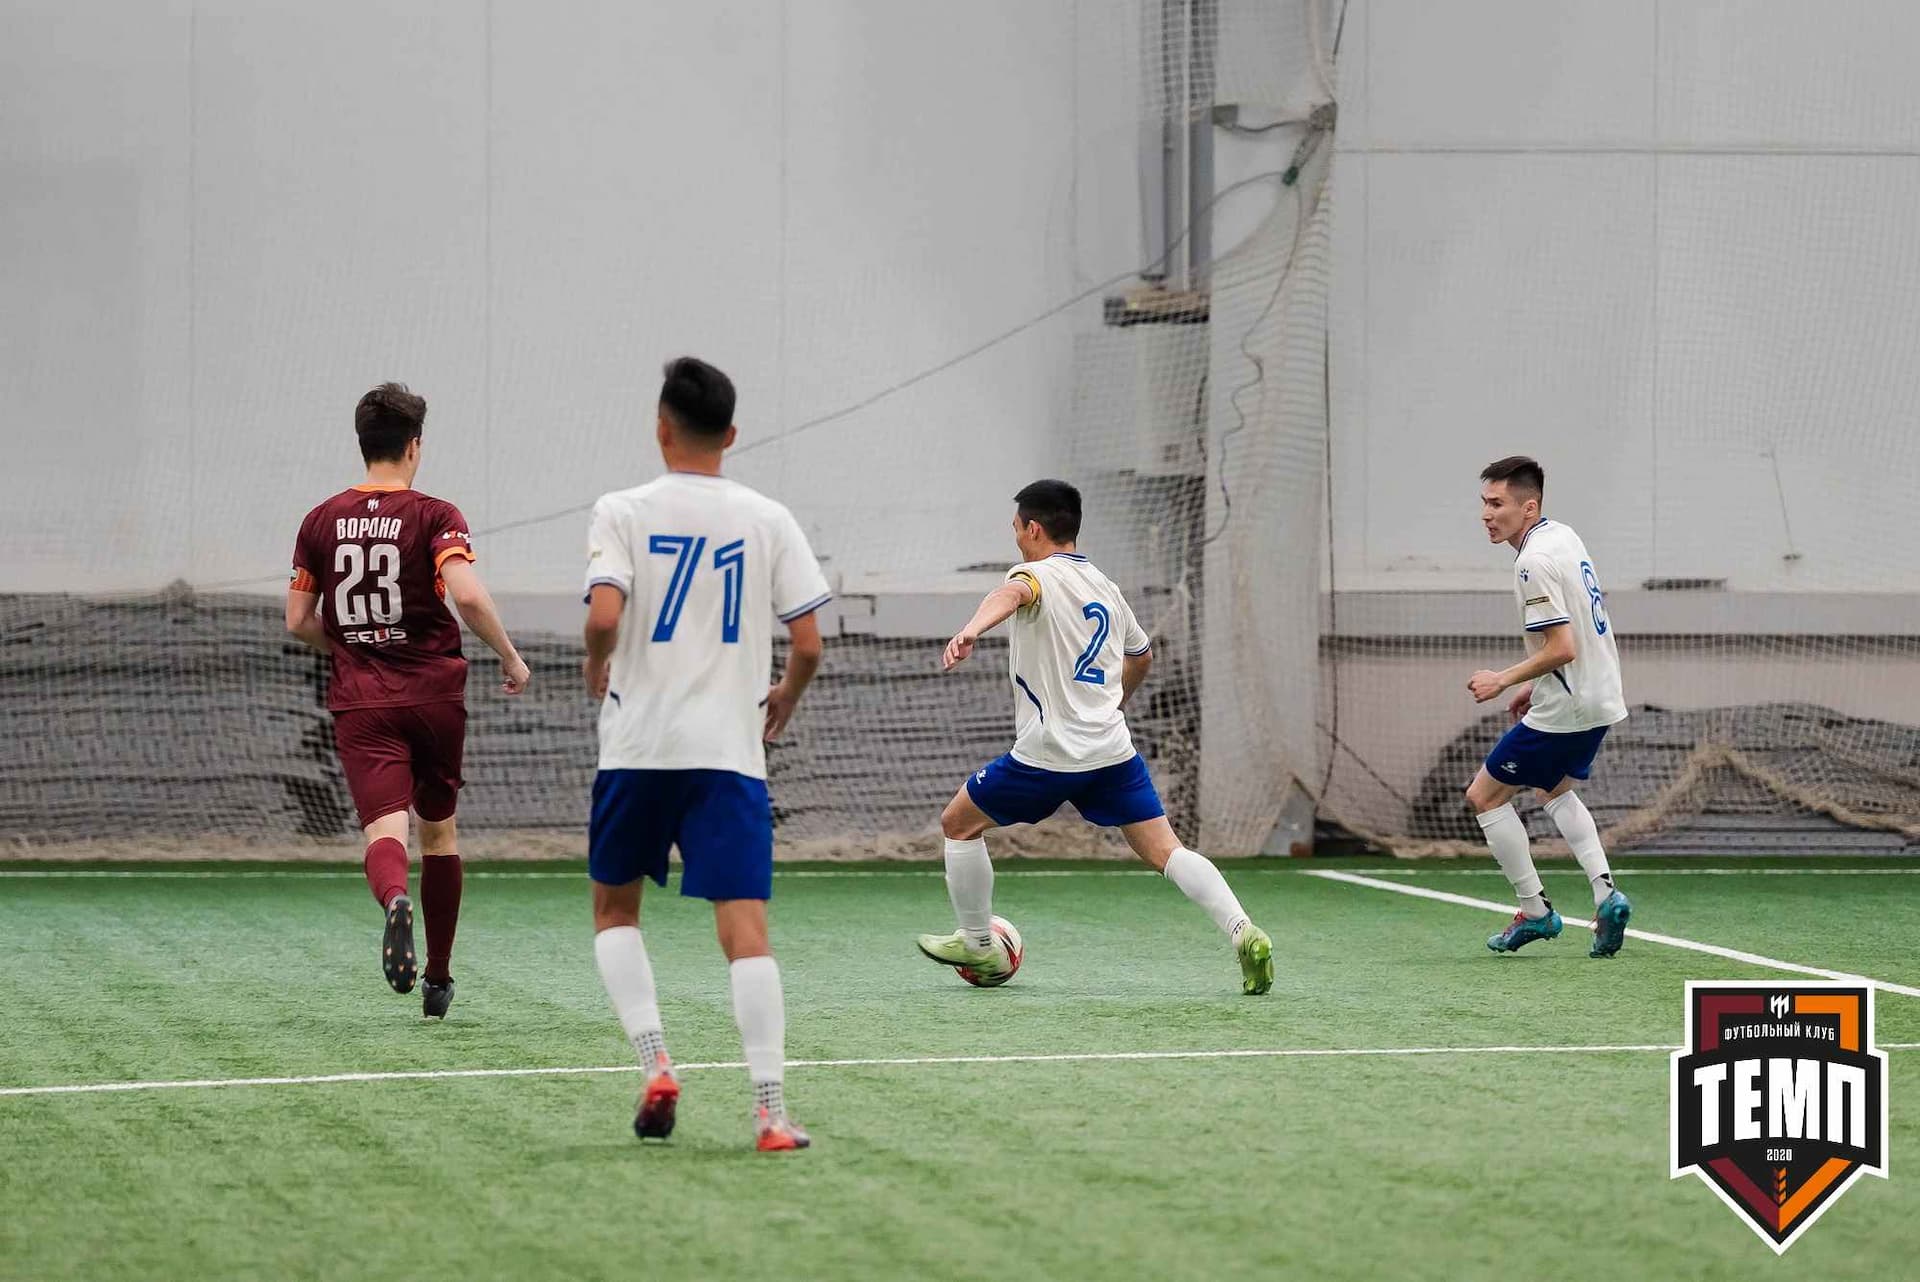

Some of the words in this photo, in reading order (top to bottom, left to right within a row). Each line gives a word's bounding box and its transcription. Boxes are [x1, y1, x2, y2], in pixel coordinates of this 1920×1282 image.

[336, 516, 403, 540] ВОРОНА
[334, 543, 403, 626] 23
[648, 534, 745, 643] 71
[1579, 560, 1608, 637] 8
[343, 627, 407, 645] SEUS
[1072, 601, 1110, 685] 2
